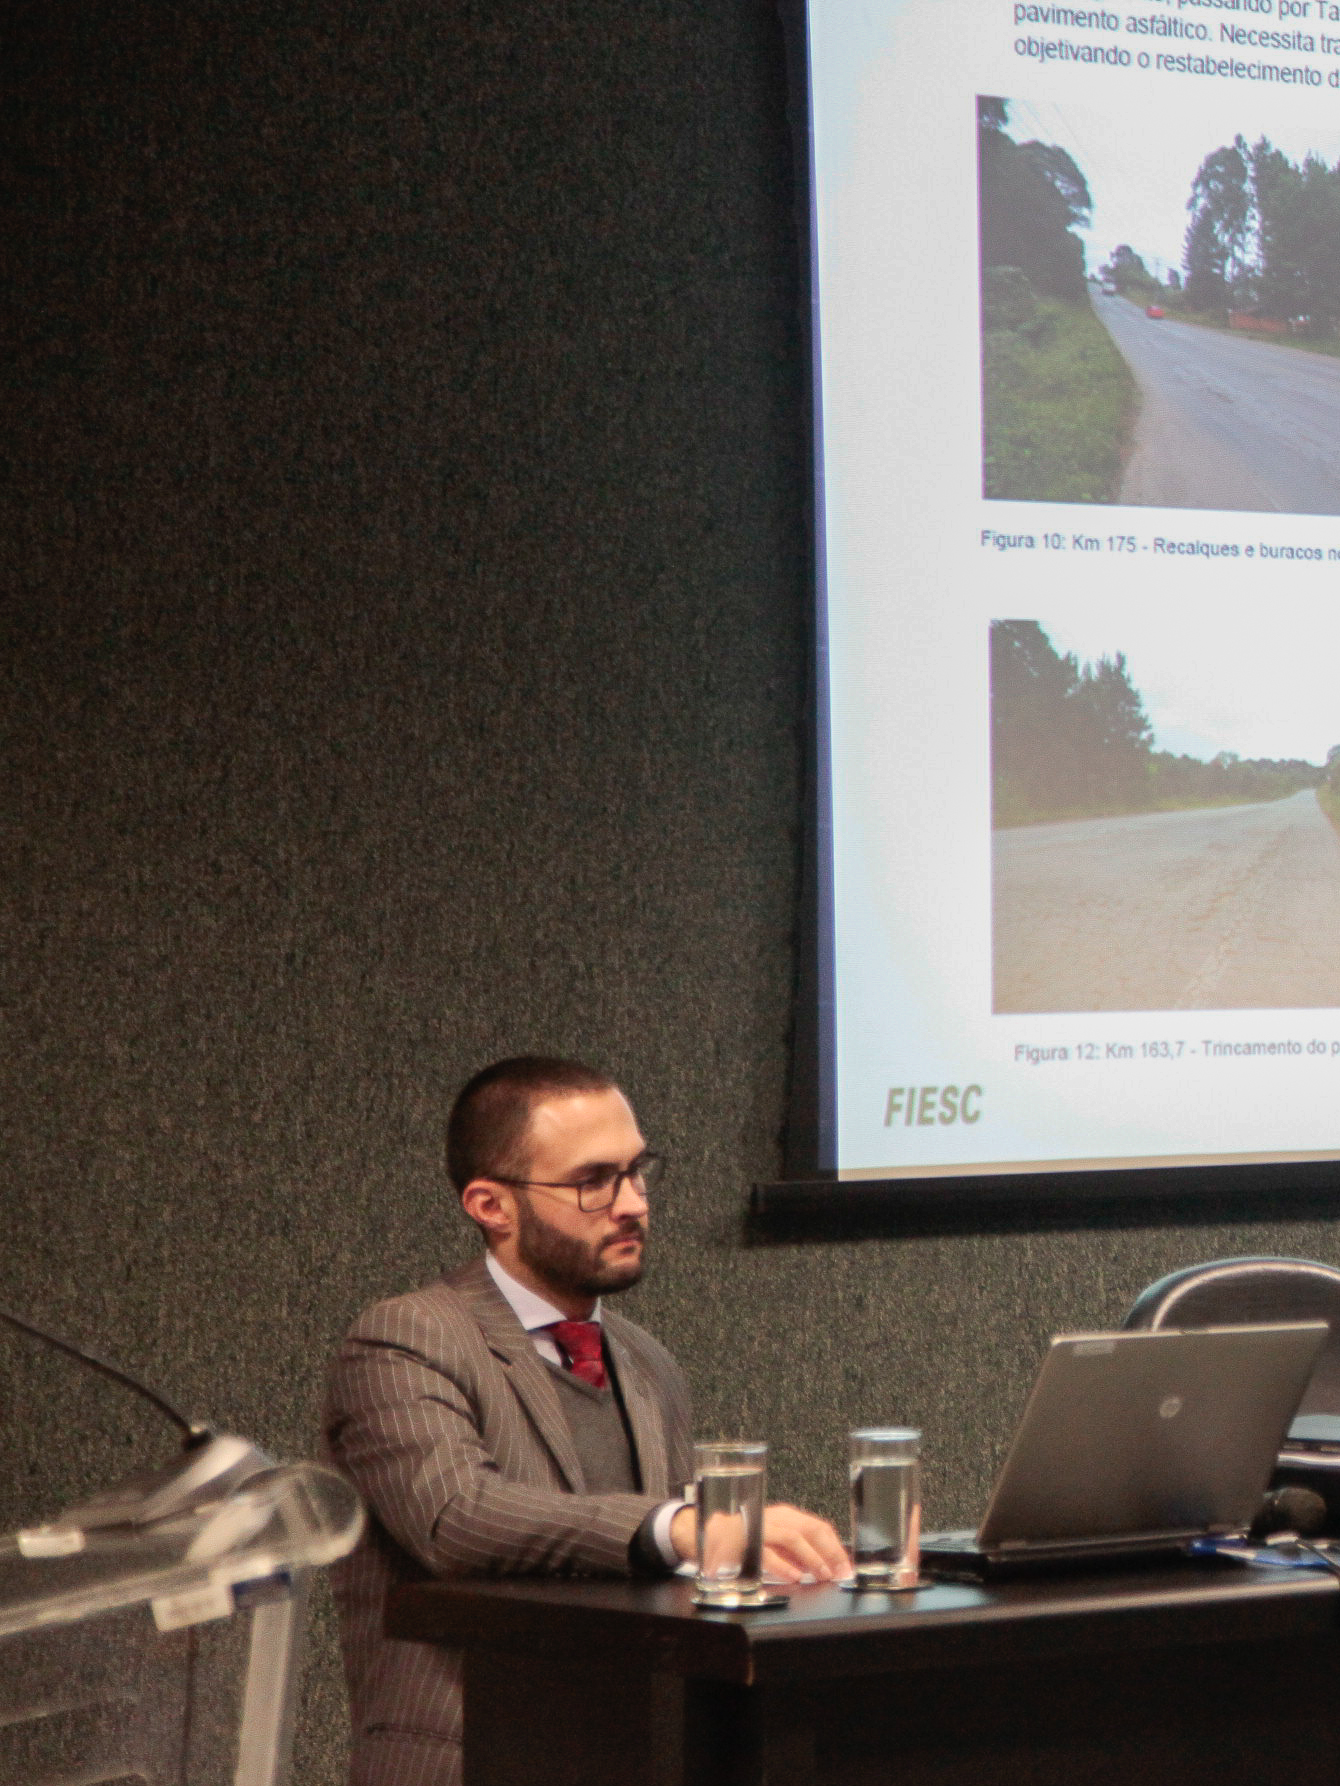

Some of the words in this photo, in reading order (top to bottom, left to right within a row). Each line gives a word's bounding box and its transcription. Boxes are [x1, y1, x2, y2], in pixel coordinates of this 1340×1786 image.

[1013, 3, 1120, 32] pavimento
[1125, 14, 1214, 42] asfáltico.
[1220, 22, 1315, 53] Necessita
[1278, 0, 1310, 21] por
[1014, 36, 1132, 67] objetivando
[1137, 51, 1151, 69] o
[1156, 53, 1322, 87] restabelecimento
[980, 529, 1035, 552] Figura
[1042, 532, 1067, 551] 10:
[1072, 534, 1100, 552] Km
[1107, 535, 1137, 553] 175
[1153, 537, 1240, 559] Recalques
[1244, 544, 1255, 558] e
[1259, 542, 1323, 561] buracos
[1013, 1043, 1069, 1066] Figura
[1076, 1043, 1100, 1061] 12:
[1105, 1043, 1134, 1060] Km
[1141, 1040, 1187, 1061] 163,7
[1202, 1039, 1303, 1057] Trincamento
[1307, 1039, 1326, 1056] do
[884, 1083, 983, 1127] FIESC
